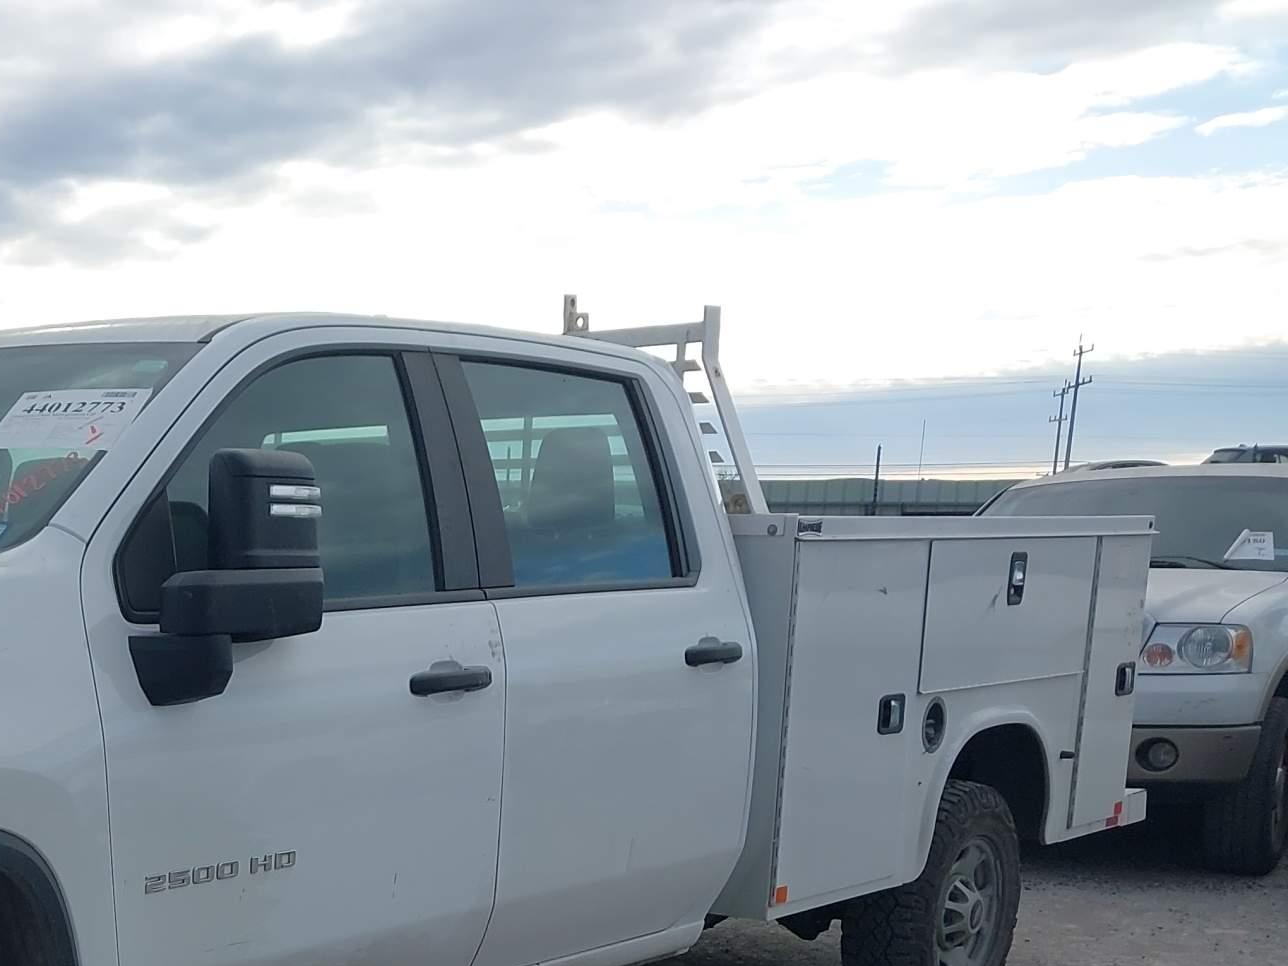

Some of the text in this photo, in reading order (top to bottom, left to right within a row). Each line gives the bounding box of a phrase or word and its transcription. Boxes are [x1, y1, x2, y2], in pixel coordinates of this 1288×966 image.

[22, 401, 127, 414] 44012773
[144, 850, 297, 894] 2500 HD
